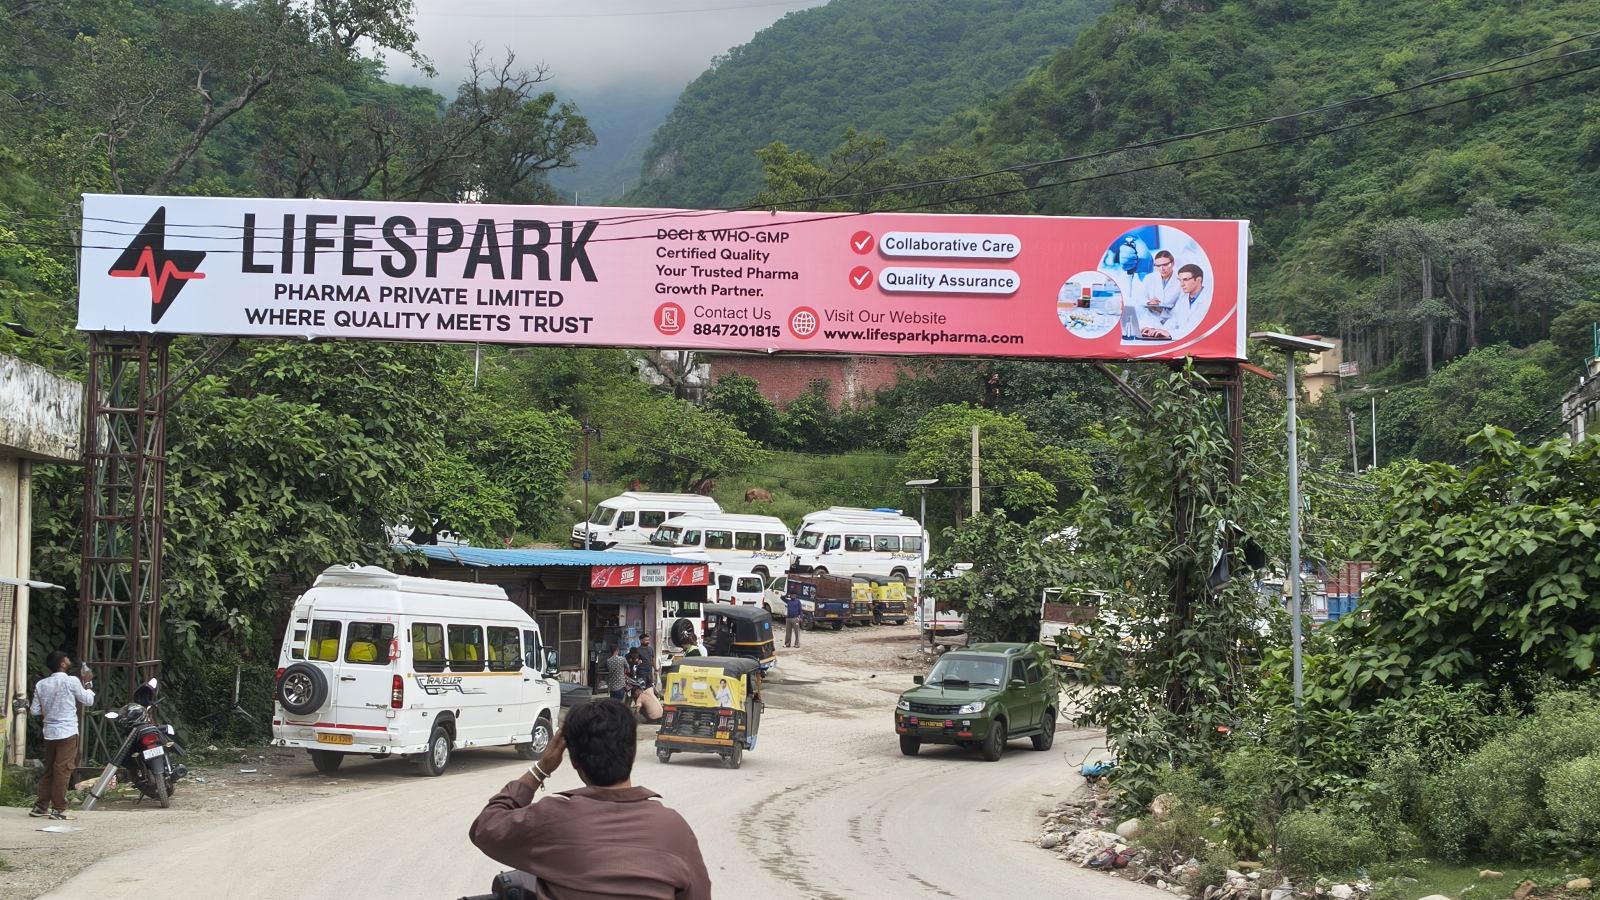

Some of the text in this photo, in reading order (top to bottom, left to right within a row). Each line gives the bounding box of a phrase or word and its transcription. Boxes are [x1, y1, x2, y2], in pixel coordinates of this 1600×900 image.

[697, 229, 707, 241] &
[711, 229, 790, 244] WHO-GMP
[241, 213, 599, 282] LIFESPARK
[885, 237, 1015, 252] Collaborative Care
[656, 246, 770, 263] Certified Quality
[655, 264, 799, 280] Your Trusted Pharma
[886, 273, 1014, 288] Quality Assurance
[274, 283, 564, 308] PHARMA PRIVATE LIMITED
[655, 282, 764, 297] Growth Partner.
[693, 305, 772, 320] Contact Us
[824, 309, 947, 324] Visit Our Website
[245, 307, 594, 334] WHERE QUALITY MEETS TRUST
[692, 323, 781, 338] 8847201815
[824, 327, 1024, 344] www.lifesparkpharma.com
